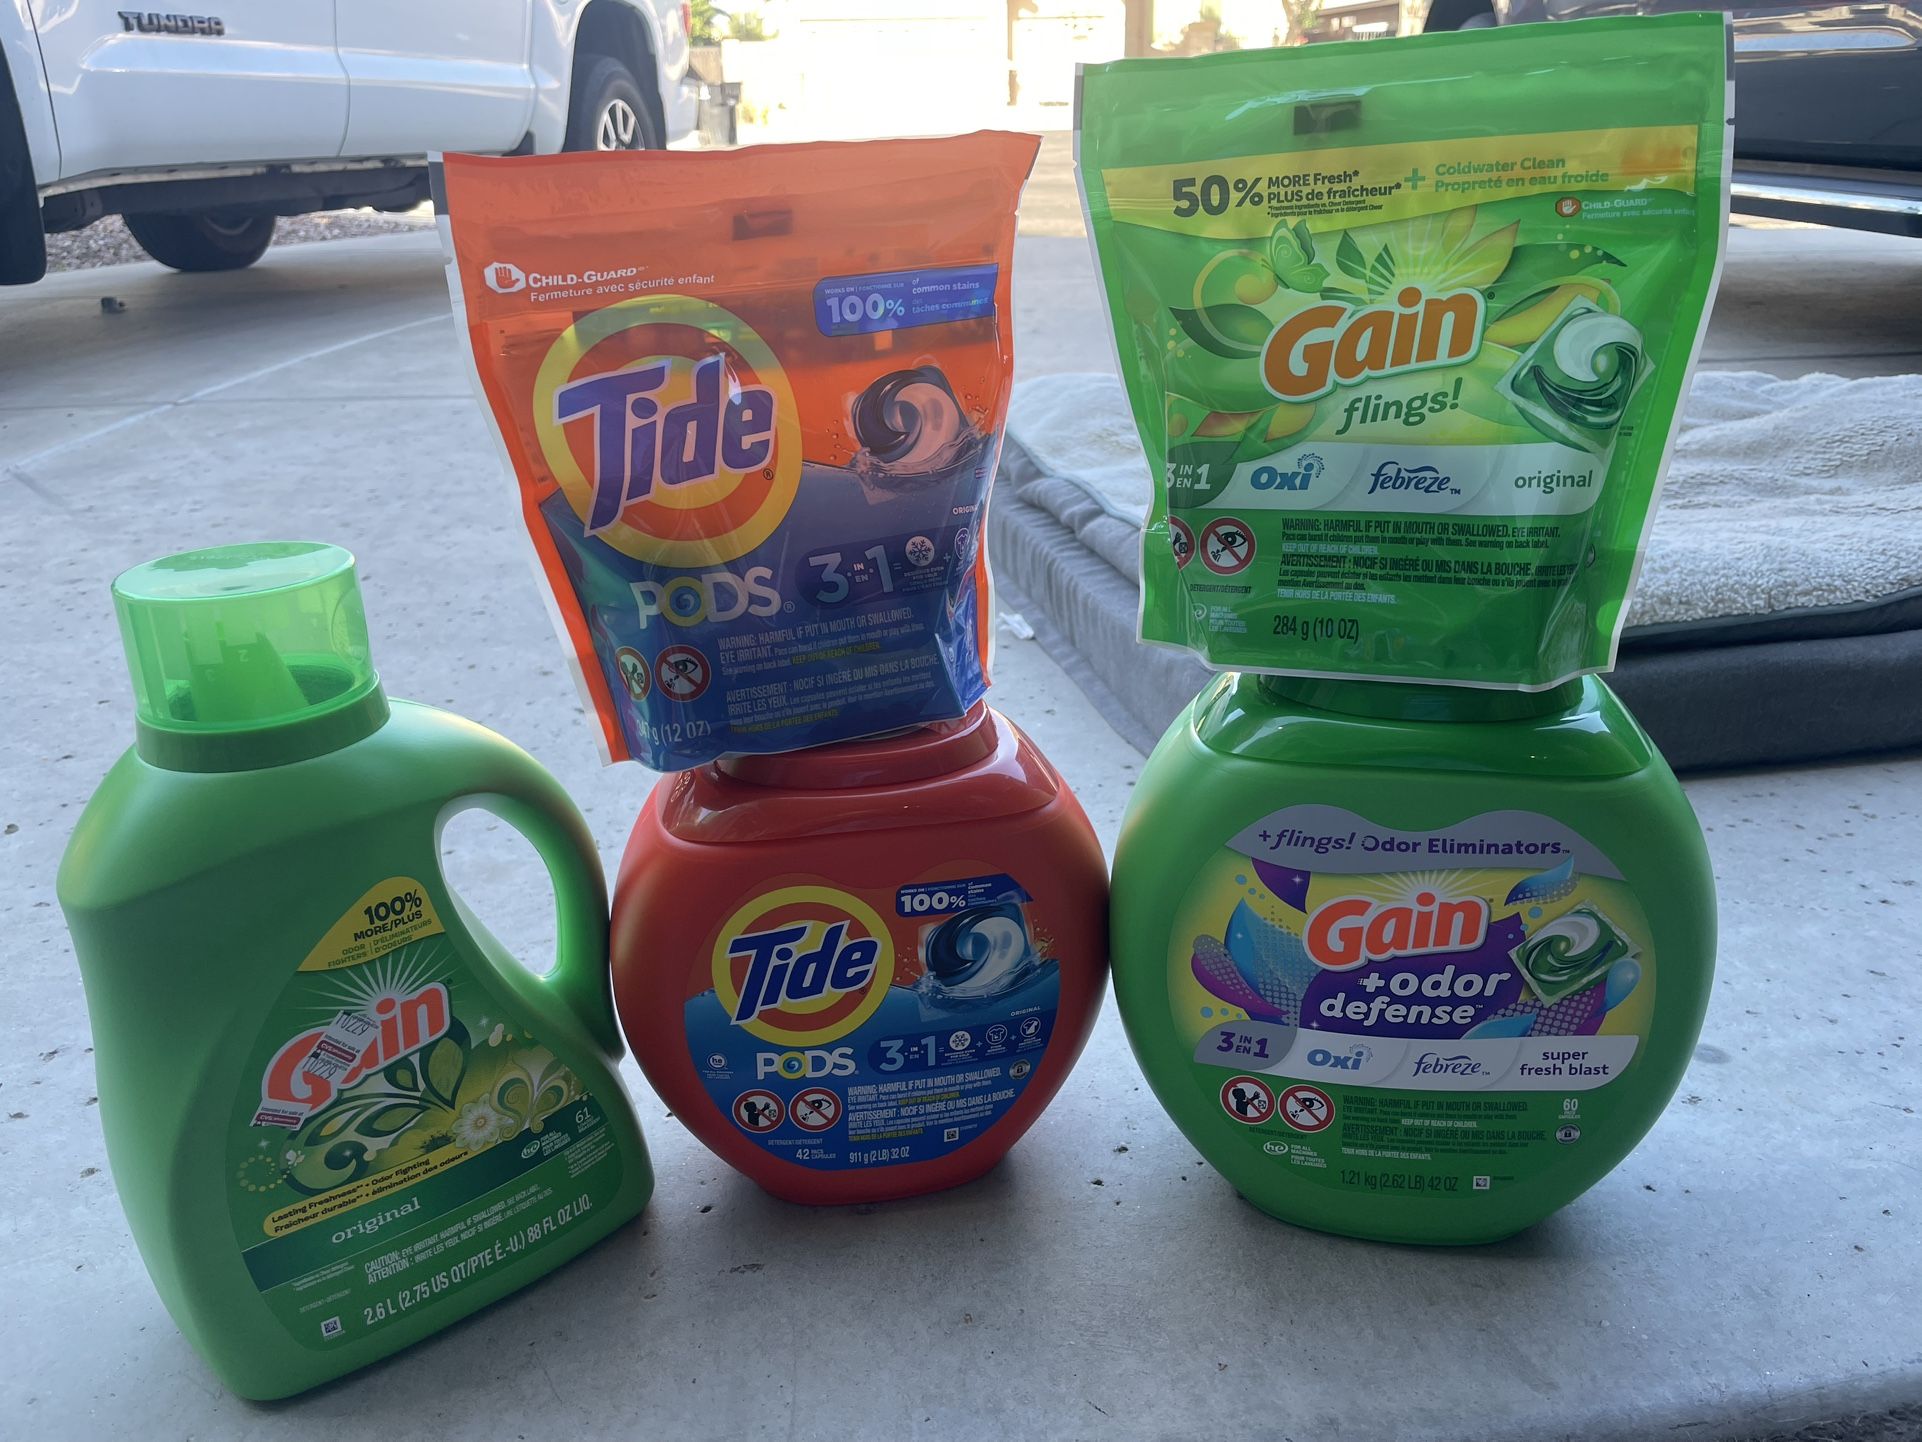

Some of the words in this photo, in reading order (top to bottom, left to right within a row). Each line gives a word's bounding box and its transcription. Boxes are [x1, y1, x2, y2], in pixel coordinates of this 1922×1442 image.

[117, 10, 225, 36] TUNDRA
[1435, 160, 1518, 177] Coldwater
[1520, 157, 1566, 171] Clean
[1267, 174, 1311, 190] MORE
[1434, 176, 1502, 193] Propreté
[1506, 176, 1525, 188] en
[1528, 175, 1558, 186] eau
[1561, 170, 1609, 184] froide
[1172, 174, 1265, 218] 50%
[1267, 189, 1304, 204] PLUS
[1305, 188, 1324, 201] de
[1582, 198, 1648, 211] CHILD-GUARD
[528, 266, 637, 288] CHILD-GUARD
[530, 287, 593, 302] Fermeture
[596, 283, 625, 295] avec
[628, 277, 674, 291] sécurité
[678, 274, 715, 285] enfant
[912, 283, 951, 295] common
[952, 281, 980, 292] stains
[825, 293, 905, 324] 100%
[1261, 286, 1485, 401] Gain
[1335, 376, 1463, 436] flings!
[553, 352, 777, 538] Tide
[1175, 477, 1192, 489] EN
[1179, 465, 1193, 475] IN
[1194, 463, 1211, 490] 1
[1250, 461, 1315, 491] Oxi
[1367, 460, 1451, 495] febreze
[1514, 470, 1593, 495] original
[1282, 517, 1322, 532] WARNING:
[1323, 519, 1363, 533] HARMFUL
[1365, 520, 1374, 533] IF
[1374, 520, 1392, 534] PUT
[1392, 521, 1403, 534] IN
[1403, 521, 1435, 535] MOUTH
[1437, 522, 1450, 535] OR
[1450, 522, 1511, 538] SWALLOWED.
[1512, 527, 1526, 538] EYE
[1526, 526, 1561, 538] IRRITANT.
[808, 552, 850, 604] 3
[853, 562, 865, 572] IN
[864, 544, 894, 593] 1
[855, 575, 869, 583] EN
[629, 566, 782, 630] PODS
[717, 633, 757, 650] WARNING:
[758, 626, 796, 643] HARMFUL
[796, 624, 804, 638] IF
[804, 622, 820, 637] PUT
[820, 620, 829, 634] IN
[829, 616, 856, 632] MOUTH
[857, 614, 867, 627] OR
[868, 606, 914, 625] SWALLOWED.
[1272, 615, 1298, 636] 284
[1300, 619, 1310, 641] g
[1313, 616, 1334, 643] (10
[1337, 618, 1360, 645] OZ)
[719, 650, 736, 664] EYE
[736, 645, 773, 662] IRRITANT.
[752, 698, 767, 712] LES
[652, 727, 659, 746] g
[661, 723, 683, 746] (12
[686, 720, 711, 740] OZ)
[1361, 835, 1422, 854] Odor
[1427, 838, 1562, 856] Eliminators
[363, 889, 423, 925] 100%
[900, 891, 966, 913] 100%
[353, 910, 423, 942] MORE/PLUS
[1303, 891, 1490, 971] Gain
[342, 943, 366, 956] ODOR
[374, 934, 413, 954] D'ODEURS
[328, 951, 368, 969] FIGHTERS
[726, 919, 883, 1025] Tide
[1010, 1005, 1041, 1017] ORIGINAL
[1319, 992, 1476, 1027] defense
[879, 1039, 905, 1072] 3
[920, 1035, 936, 1067] 1
[1216, 1030, 1236, 1053] 3
[1238, 1034, 1253, 1045] IN
[1253, 1037, 1269, 1059] 1
[1235, 1044, 1251, 1055] EN
[1541, 1049, 1589, 1065] super
[756, 1047, 857, 1081] PODS
[1306, 1048, 1364, 1070] Oxi
[1412, 1052, 1482, 1078] febreze
[1519, 1063, 1563, 1076] fresh
[1568, 1063, 1609, 1076] blast
[847, 1085, 878, 1096] WARNING:
[878, 1082, 908, 1093] HARMFUL
[908, 1080, 914, 1090] IF
[914, 1079, 927, 1089] PUT
[926, 1078, 934, 1088] IN
[934, 1074, 956, 1087] MOUTH
[955, 1073, 964, 1084] OR
[965, 1066, 1002, 1082] SWALLOWED.
[575, 1106, 592, 1124] 61
[848, 1108, 896, 1122] AVERTISSEMENT
[900, 1106, 919, 1117] NOCIF
[918, 1104, 925, 1114] SI
[946, 1099, 956, 1110] OU
[956, 1098, 967, 1109] MIS
[967, 1095, 984, 1107] DANS
[984, 1094, 992, 1103] LA
[992, 1088, 1016, 1102] BOUCHE.
[1562, 1098, 1579, 1112] 60
[795, 1148, 810, 1160] 42
[849, 1151, 862, 1163] 911
[863, 1153, 869, 1165] g
[870, 1150, 877, 1163] (2
[878, 1148, 890, 1162] LB)
[890, 1147, 900, 1159] 32
[900, 1146, 910, 1158] OZ
[1266, 1142, 1284, 1152] he
[371, 1173, 422, 1196] élimination
[422, 1165, 438, 1176] des
[439, 1151, 469, 1168] odeurs
[1341, 1169, 1360, 1185] 1.21
[1364, 1171, 1377, 1190] kg
[1408, 1173, 1425, 1193] LB)
[1427, 1175, 1441, 1191] 42
[1443, 1176, 1459, 1192] OZ
[271, 1205, 307, 1224] Lasting
[371, 1172, 394, 1186] Odor
[395, 1158, 431, 1177] Fighting
[331, 1196, 421, 1244] original
[363, 1303, 386, 1326] 2.6
[386, 1297, 398, 1316] L
[399, 1281, 430, 1312] (2.75
[431, 1271, 450, 1293] US
[451, 1249, 495, 1285] QT/PTE
[494, 1231, 526, 1261] É.-U.)
[527, 1223, 542, 1244] 88
[543, 1215, 557, 1236] FL
[557, 1207, 572, 1227] OZ
[573, 1193, 593, 1216] LIQ.
